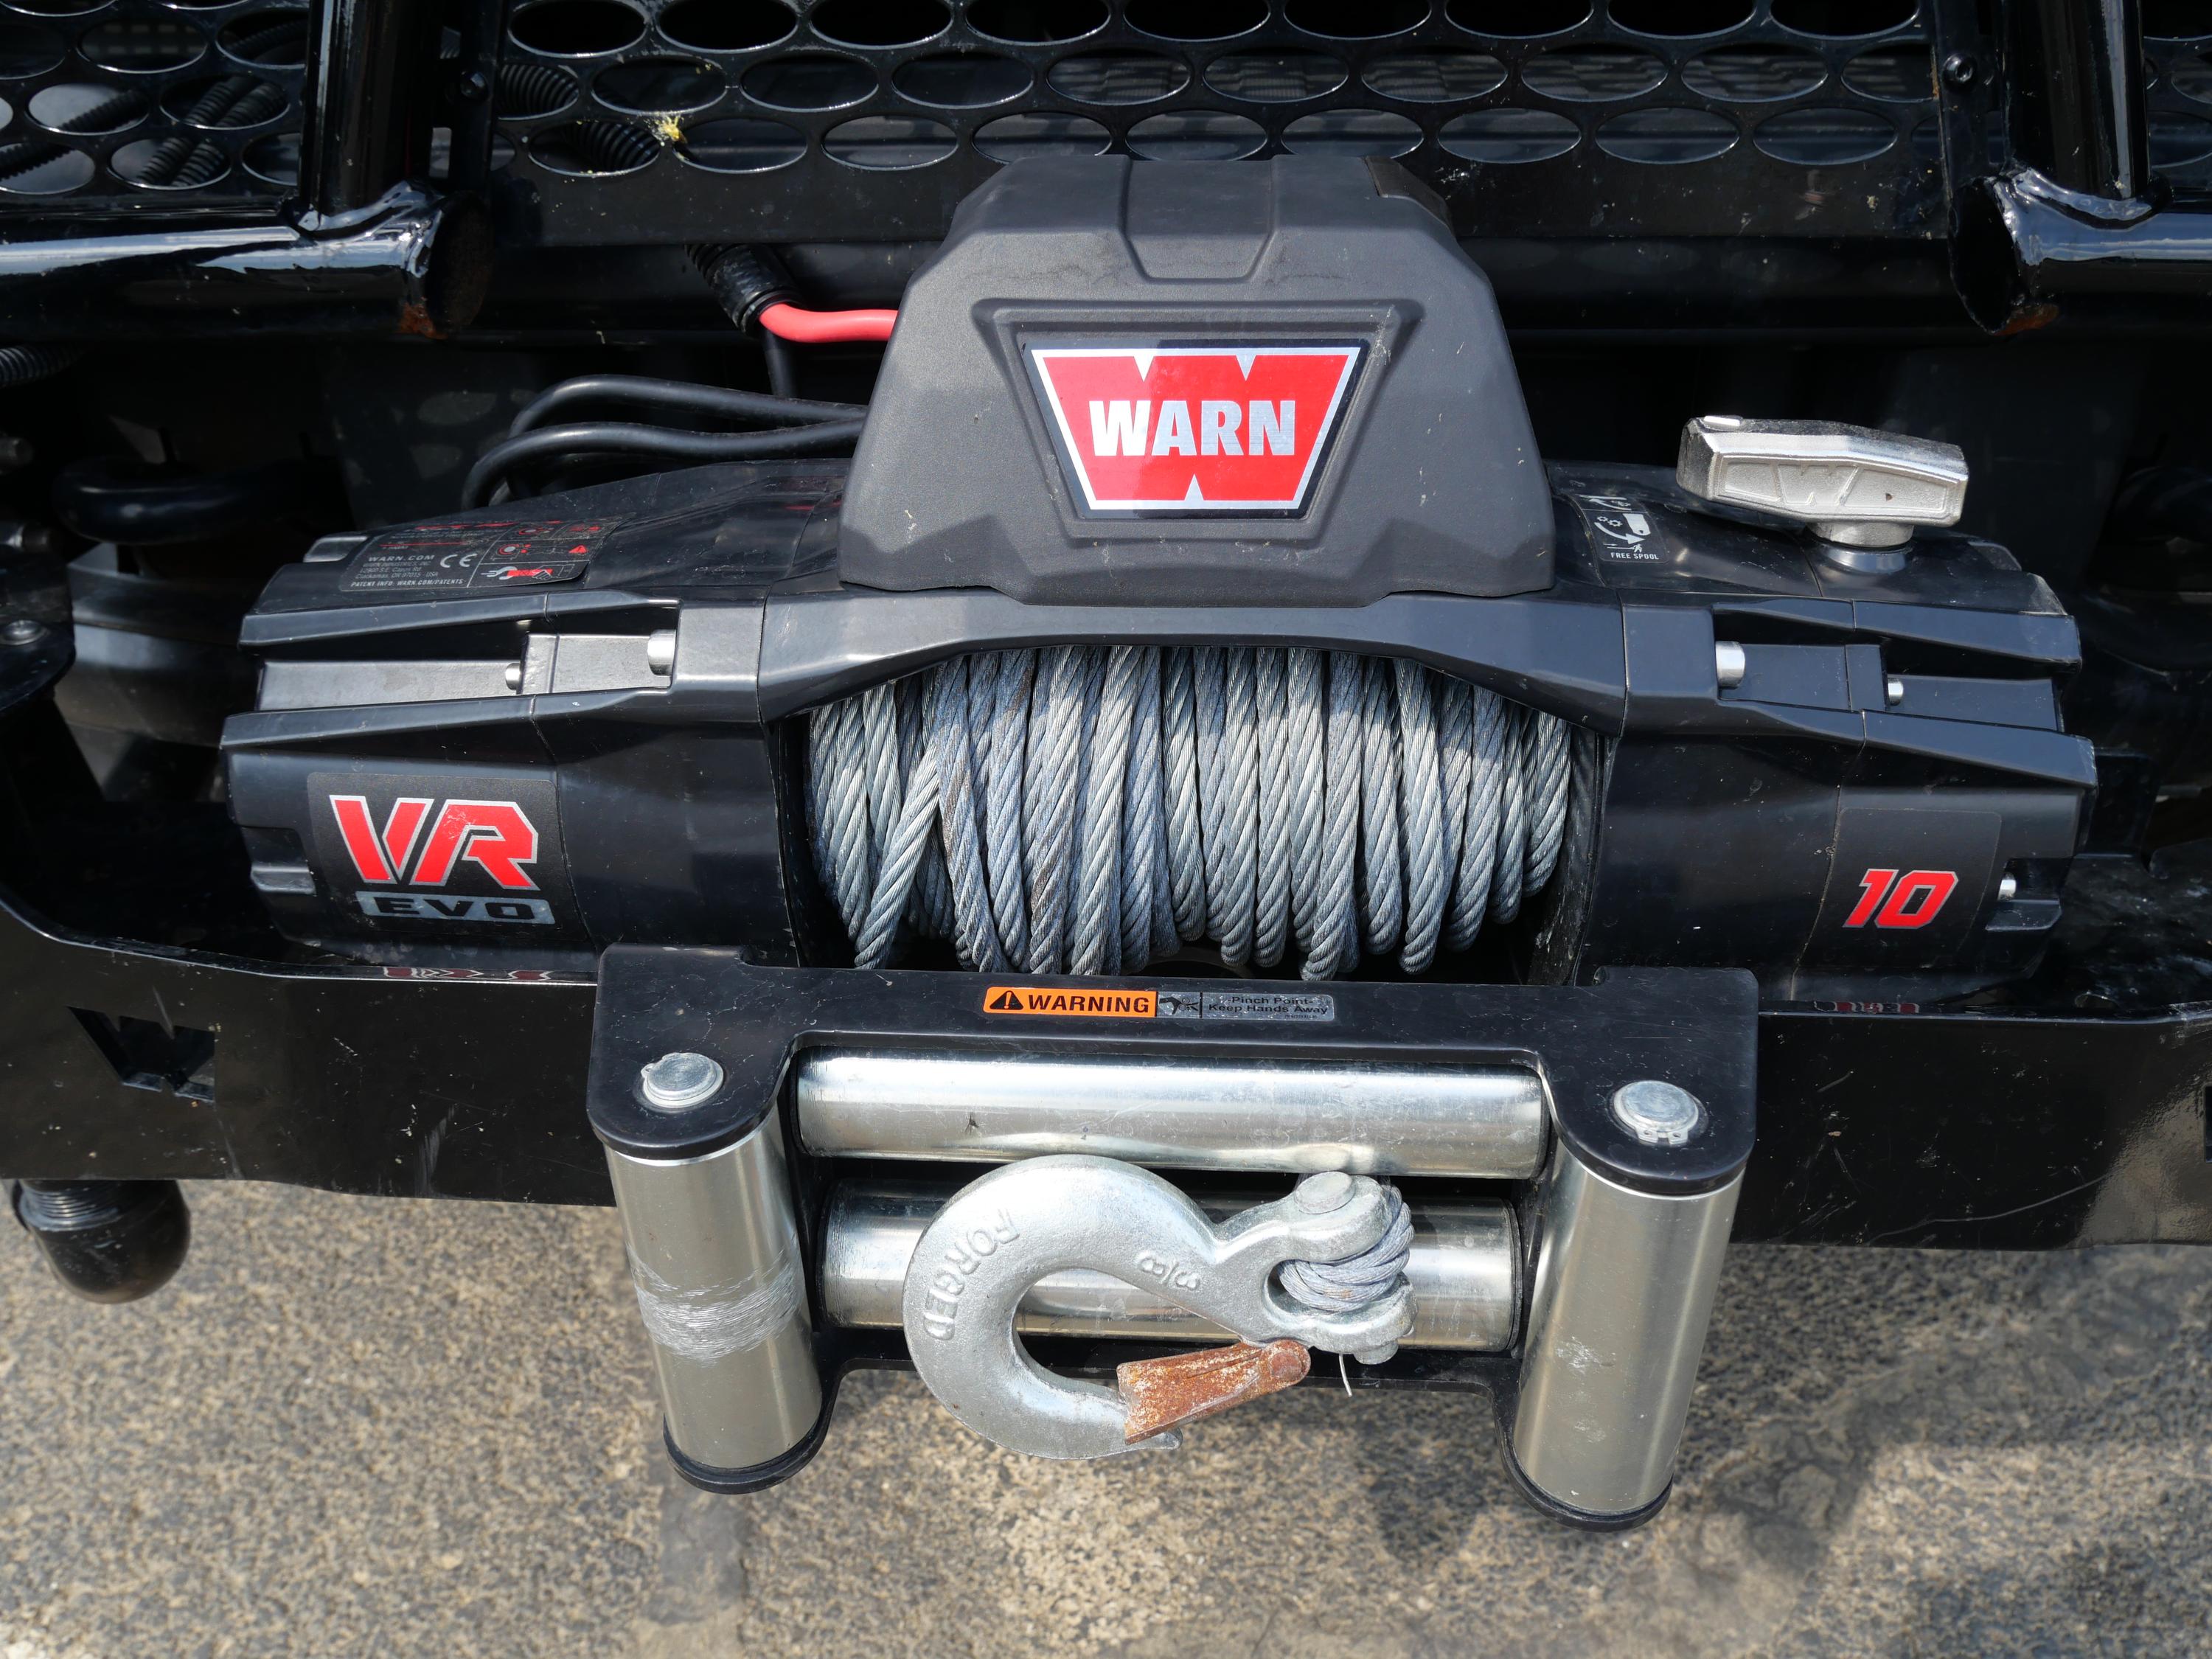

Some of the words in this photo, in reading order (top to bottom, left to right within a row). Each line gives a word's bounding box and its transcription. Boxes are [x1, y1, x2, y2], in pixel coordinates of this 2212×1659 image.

[1088, 400, 1295, 456] WARN
[329, 795, 540, 891] VR
[373, 897, 535, 920] EVO
[1842, 869, 1958, 929] 10
[1028, 994, 1150, 1014] WARNING
[1208, 1004, 1242, 1013] Keep
[1246, 1004, 1289, 1013] Hands
[1293, 1005, 1328, 1015] Away
[924, 1209, 1021, 1340] FORGED
